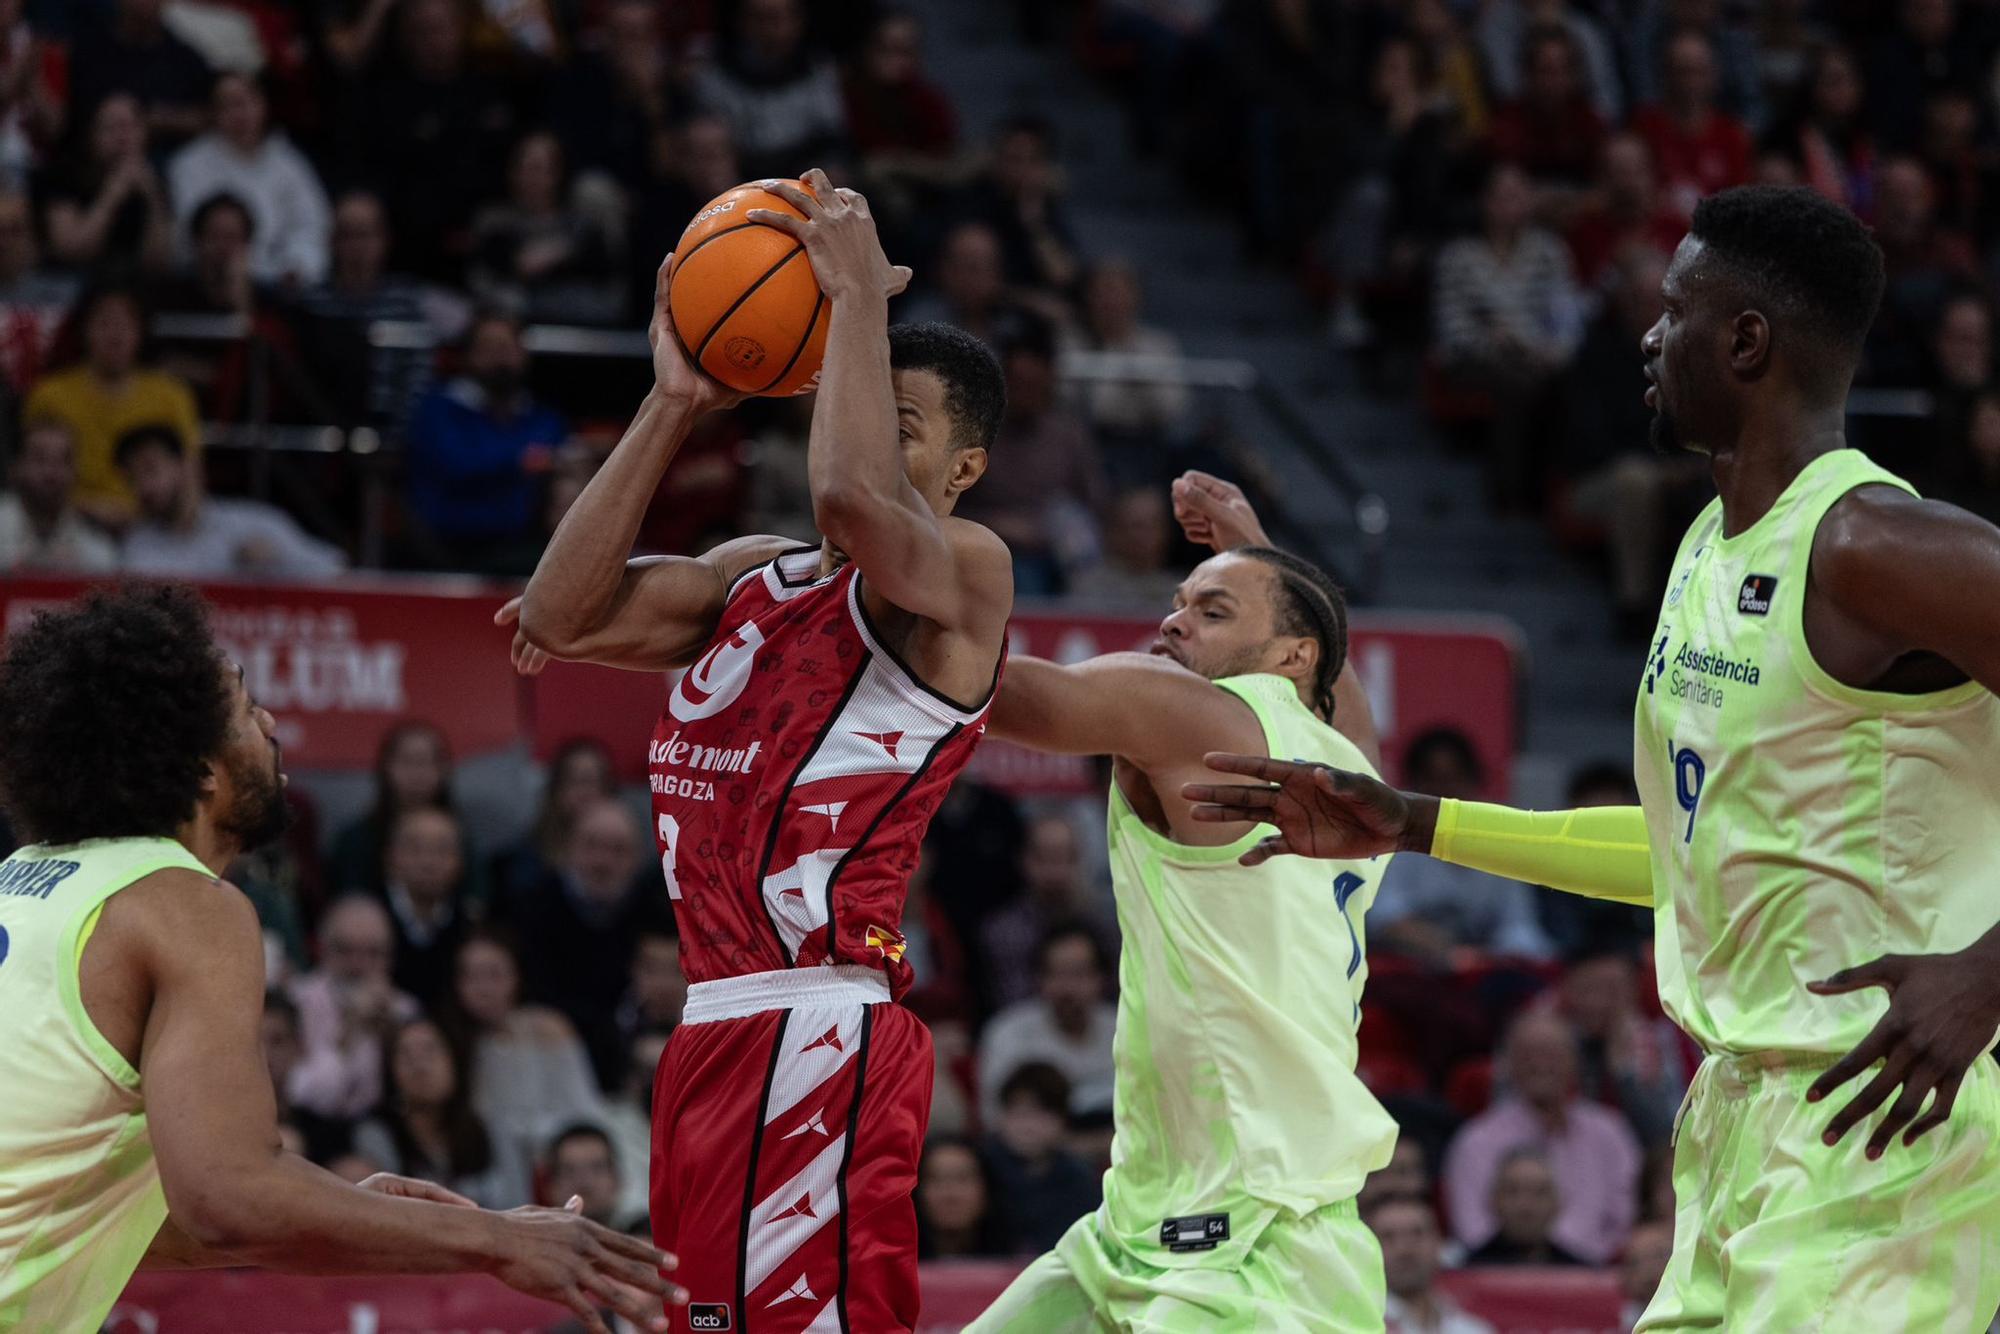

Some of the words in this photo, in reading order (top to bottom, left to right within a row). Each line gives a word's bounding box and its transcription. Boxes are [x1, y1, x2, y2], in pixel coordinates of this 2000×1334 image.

[1673, 642, 1760, 686] Assistència
[1670, 670, 1723, 708] Sanitària
[649, 773, 715, 801] RAGOZA
[1209, 1221, 1223, 1233] 54
[692, 1314, 720, 1327] acb
